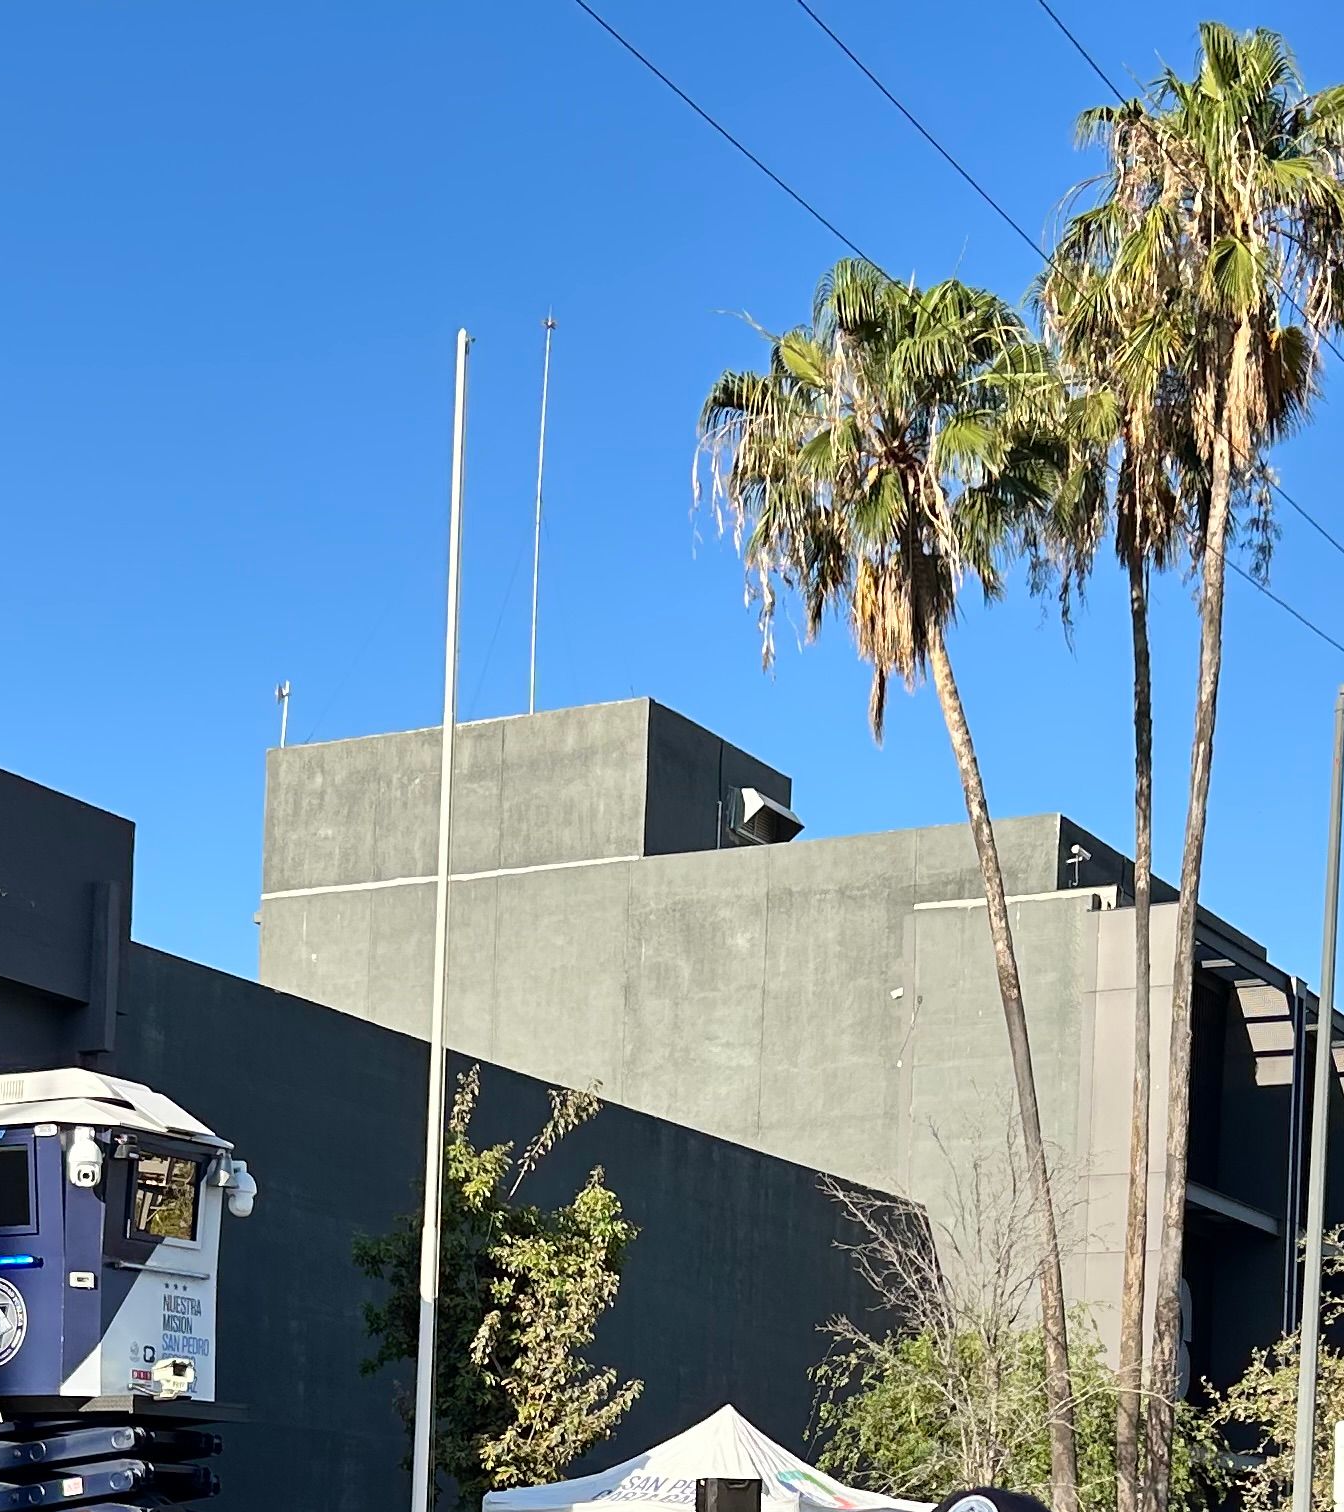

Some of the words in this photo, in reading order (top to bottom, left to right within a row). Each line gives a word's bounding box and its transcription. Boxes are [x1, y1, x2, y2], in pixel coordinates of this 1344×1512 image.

[162, 1293, 202, 1316] NUESTRA
[162, 1332, 180, 1353] SAN
[182, 1335, 210, 1357] PEDRO
[621, 1475, 669, 1492] SAN
[666, 1479, 696, 1495] PE
